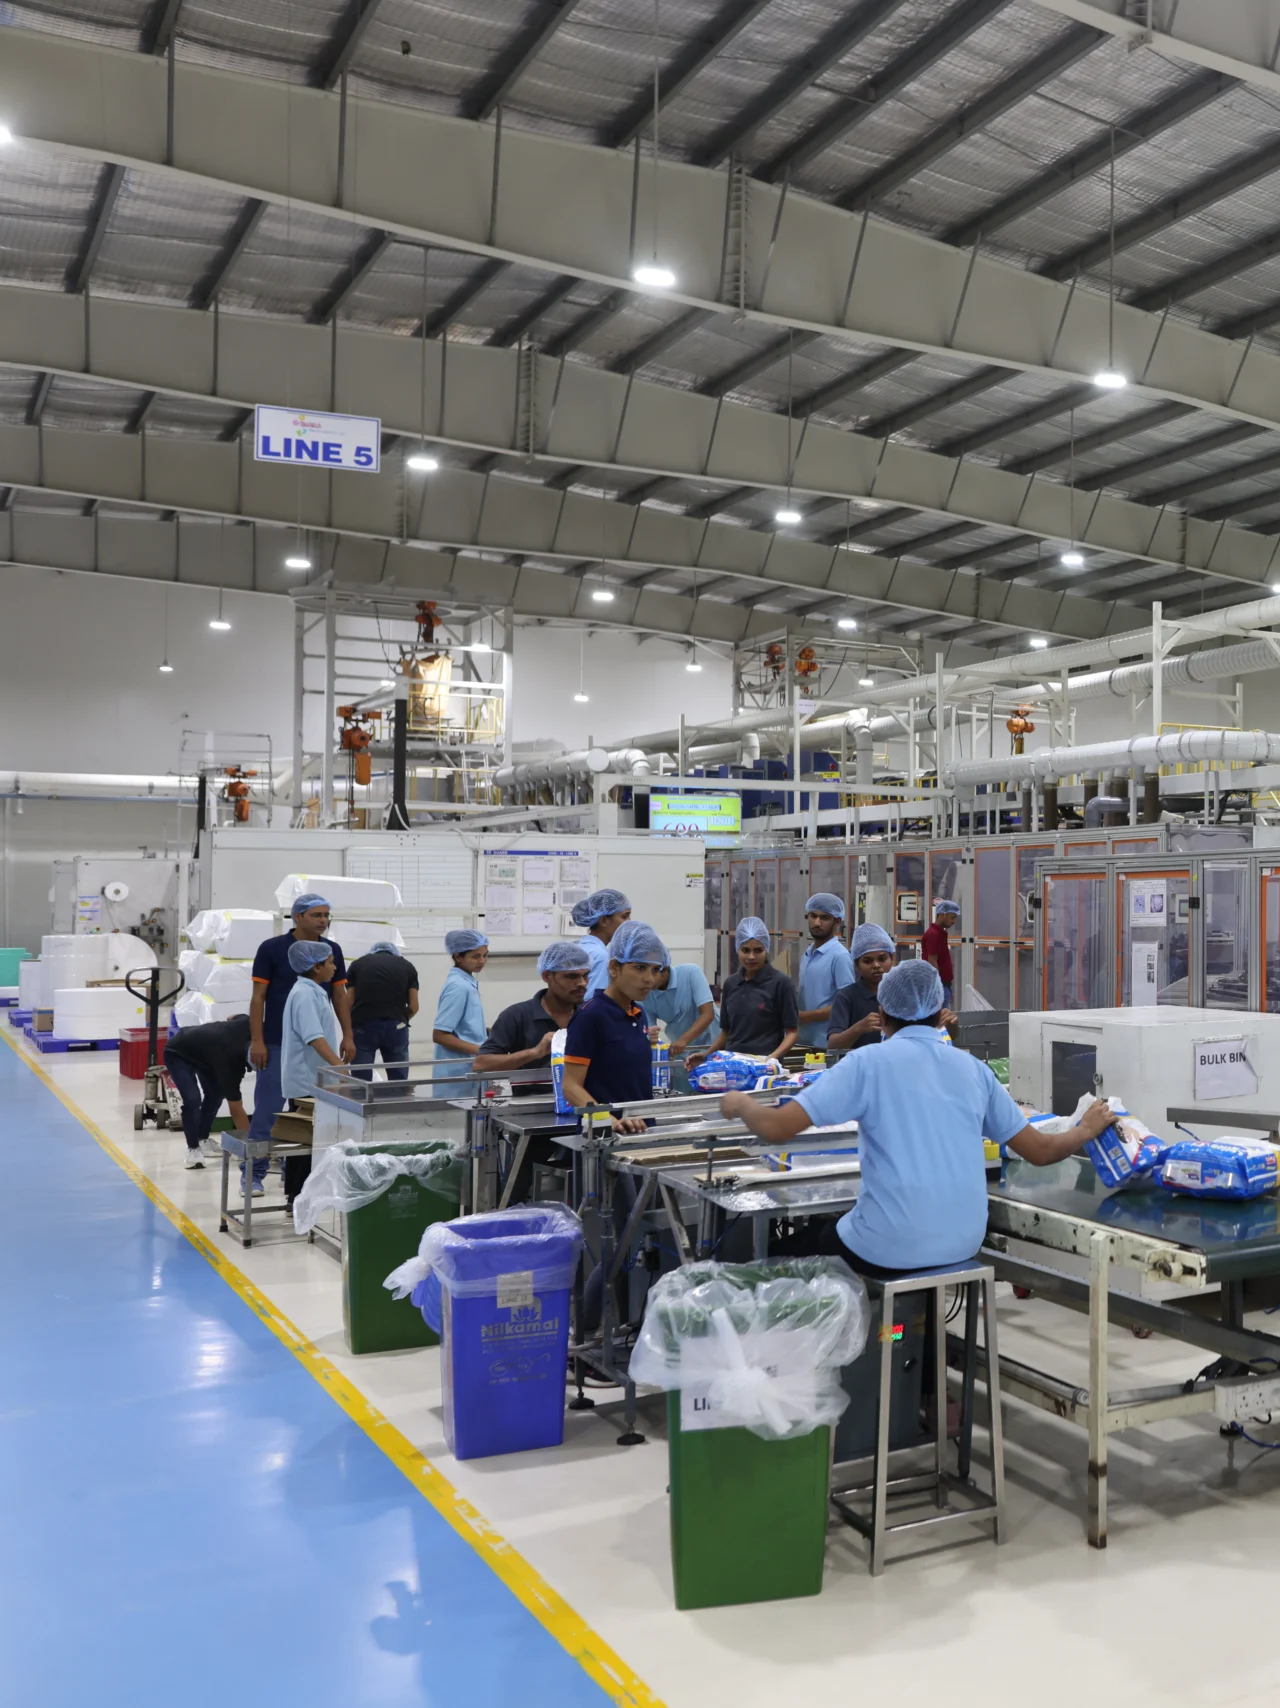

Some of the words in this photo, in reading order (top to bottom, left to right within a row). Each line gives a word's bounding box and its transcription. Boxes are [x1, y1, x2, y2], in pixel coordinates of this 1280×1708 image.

[261, 435, 343, 463] LINE
[353, 446, 373, 466] 5
[1200, 1053, 1227, 1066] BULK
[1229, 1052, 1246, 1063] BIN
[481, 1317, 559, 1337] Nilkamal
